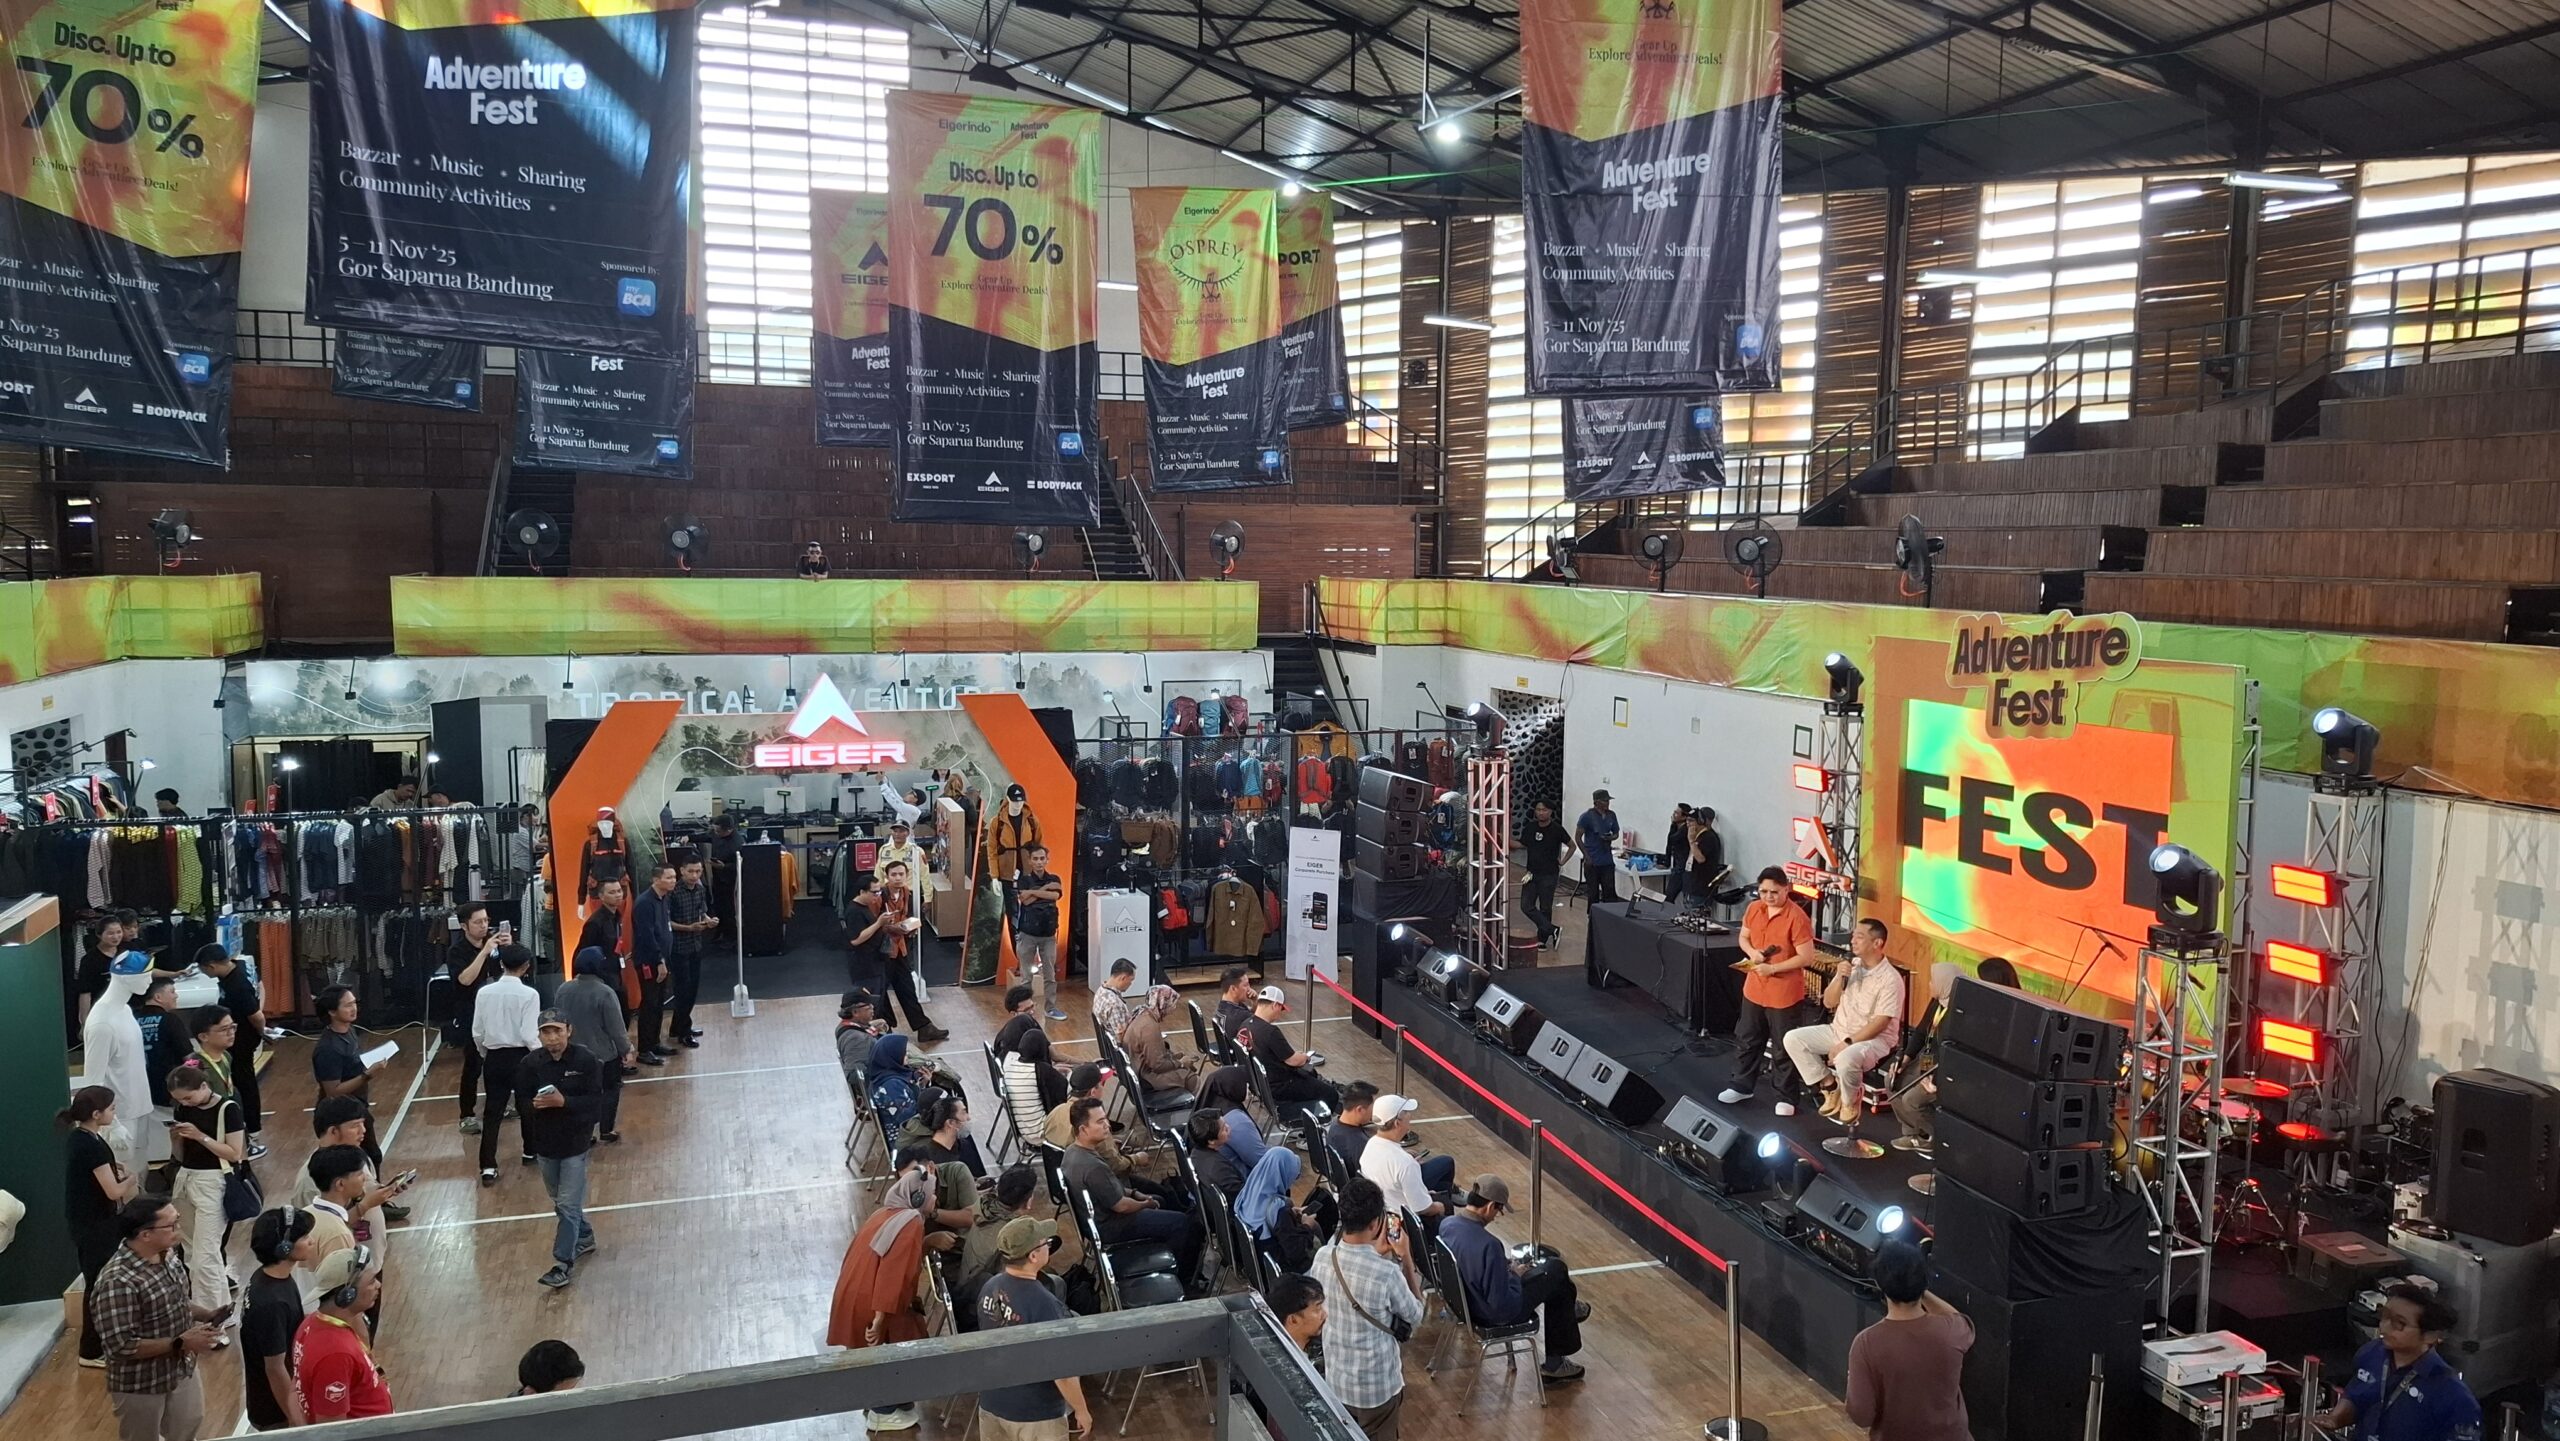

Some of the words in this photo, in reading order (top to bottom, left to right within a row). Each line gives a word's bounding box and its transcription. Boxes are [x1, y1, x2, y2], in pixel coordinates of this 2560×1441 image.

[54, 21, 111, 56] Disc.
[116, 34, 143, 66] Up
[148, 44, 176, 67] to
[1663, 40, 1678, 52] Up
[1588, 47, 1632, 62] Explore
[424, 55, 587, 91] Adventure
[16, 55, 204, 159] 70%
[469, 92, 539, 125] Fest
[1010, 121, 1049, 132] Adventure
[1020, 131, 1038, 140] Fest
[340, 140, 402, 166] Bazzar
[430, 154, 484, 178] Music
[517, 165, 587, 194] Sharing
[950, 161, 991, 185] Disc.
[995, 165, 1015, 190] Up
[1018, 167, 1038, 188] to
[1602, 152, 1711, 189] Adventure
[339, 169, 449, 204] Community
[450, 185, 532, 211] Activities
[1632, 183, 1678, 214] Fest
[923, 193, 1064, 265] 70%
[338, 236, 349, 253] 5
[369, 240, 385, 256] 11
[389, 239, 428, 261] Nov
[1169, 239, 1244, 261] OSPREY
[1543, 242, 1586, 257] Bazzar
[1606, 243, 1644, 257] Music
[1665, 242, 1711, 259] Sharing
[600, 260, 646, 273] Sponsored
[1542, 265, 1619, 283] Community
[1619, 266, 1675, 281] Activities
[43, 261, 84, 279] Music
[107, 272, 160, 293] Sharing
[338, 256, 379, 279] Gor
[381, 261, 463, 291] Saparua
[467, 272, 554, 301] Bandung
[57, 284, 118, 304] Activities
[941, 280, 974, 291] Explore
[1022, 285, 1048, 295] Deals!
[622, 292, 651, 307] BCA
[9, 318, 39, 335] Nov
[1543, 321, 1550, 334] 5
[1578, 317, 1605, 335] Nov
[1, 334, 62, 356] Saparua
[66, 344, 133, 367] Bandung
[1284, 345, 1302, 359] Fest
[1544, 337, 1570, 353] Gor
[1572, 337, 1628, 356] Saparua
[1631, 335, 1690, 354] Bandung
[591, 355, 624, 372] Fest
[867, 357, 890, 370] Fest
[906, 365, 939, 378] Bazzar
[954, 368, 984, 380] Music
[1002, 370, 1040, 384] Sharing
[1186, 366, 1245, 389] Adventure
[572, 385, 598, 396] Music
[613, 389, 646, 402] Sharing
[906, 382, 965, 397] Community
[965, 385, 1011, 398] Activities
[1202, 383, 1228, 399] Fest
[64, 402, 108, 415] EIGER
[531, 393, 580, 408] Community
[581, 399, 620, 411] Activities
[146, 405, 208, 423] BODYPACK
[1190, 413, 1210, 421] Music
[1222, 412, 1248, 420] Sharing
[552, 424, 571, 435] Nov
[907, 421, 913, 431] 5
[933, 420, 954, 432] Nov
[1157, 426, 1197, 435] Community
[1198, 424, 1229, 433] Activities
[1627, 419, 1667, 431] Bandung
[529, 433, 547, 444] Gor
[548, 435, 587, 448] Saparua
[588, 439, 630, 453] Bandung
[907, 433, 927, 446] Gor
[928, 434, 973, 448] Saparua
[975, 436, 1024, 451] Bandung
[1061, 441, 1078, 450] BCA
[1178, 451, 1192, 459] Nov
[1576, 457, 1613, 468] EXSPORT
[1676, 451, 1715, 462] BODYPACK
[1159, 462, 1175, 471] Gor
[1176, 461, 1206, 471] Saparua
[1206, 459, 1240, 468] Bandung
[906, 472, 956, 483] EXSPORT
[1037, 480, 1083, 491] BODYPACK
[1952, 622, 2130, 676] Adventure
[1991, 678, 2067, 728] Fest
[754, 740, 907, 768] EIGER
[1898, 767, 2169, 913] FEST
